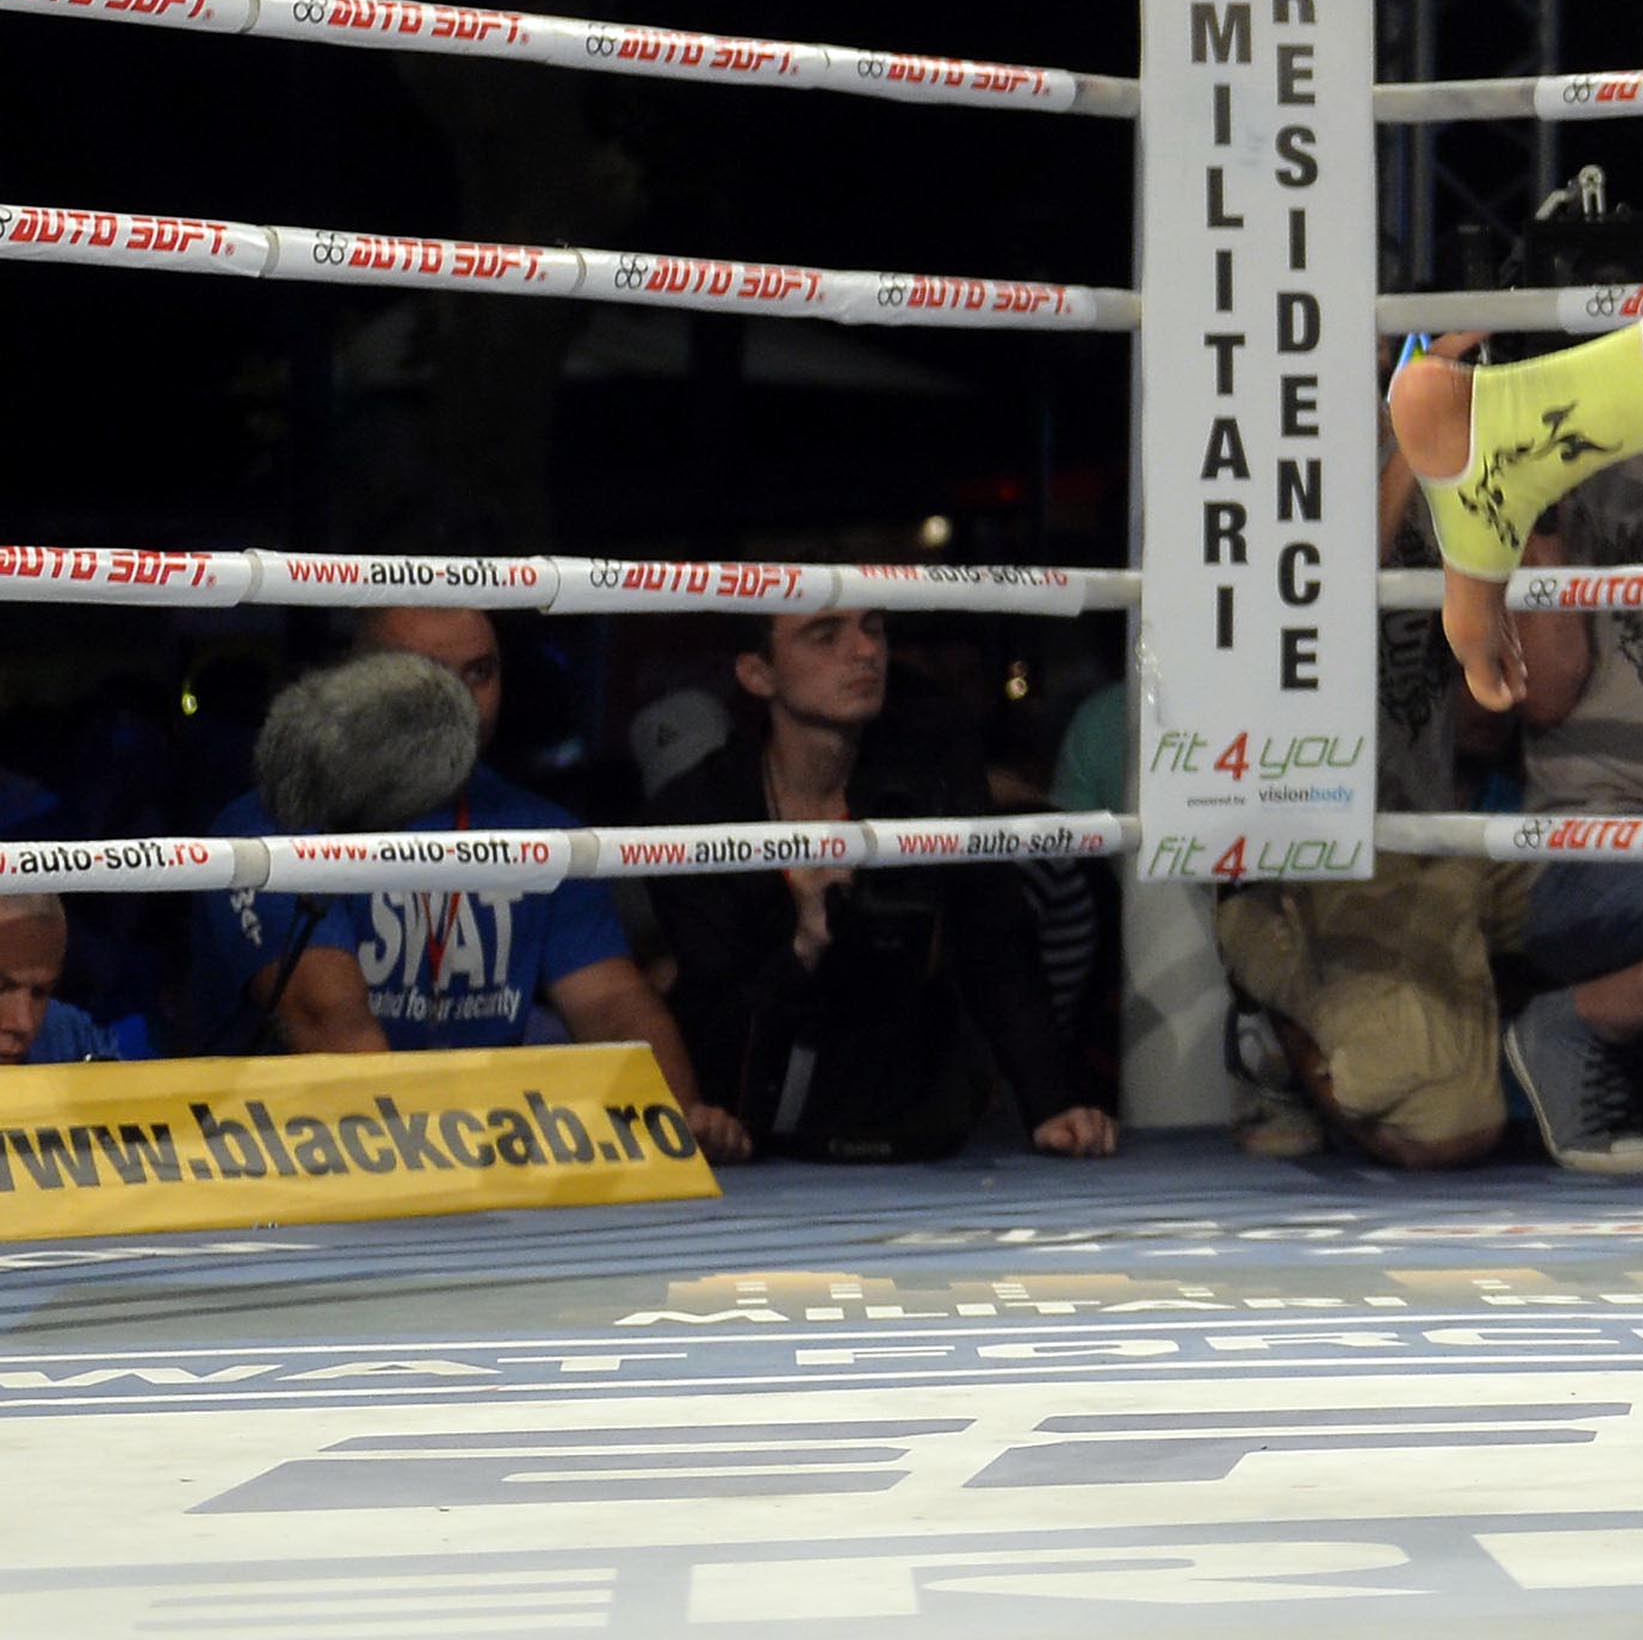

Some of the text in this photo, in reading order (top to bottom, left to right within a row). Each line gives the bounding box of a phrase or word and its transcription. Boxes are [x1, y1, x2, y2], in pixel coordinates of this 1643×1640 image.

[1190, 2, 1253, 650] MILITARI
[288, 558, 537, 589] www.auto-soft.ro
[0, 840, 208, 875] .auto-soft.ro
[620, 838, 846, 865] www.auto-soft.ro
[613, 1296, 1408, 1326] MILITARI
